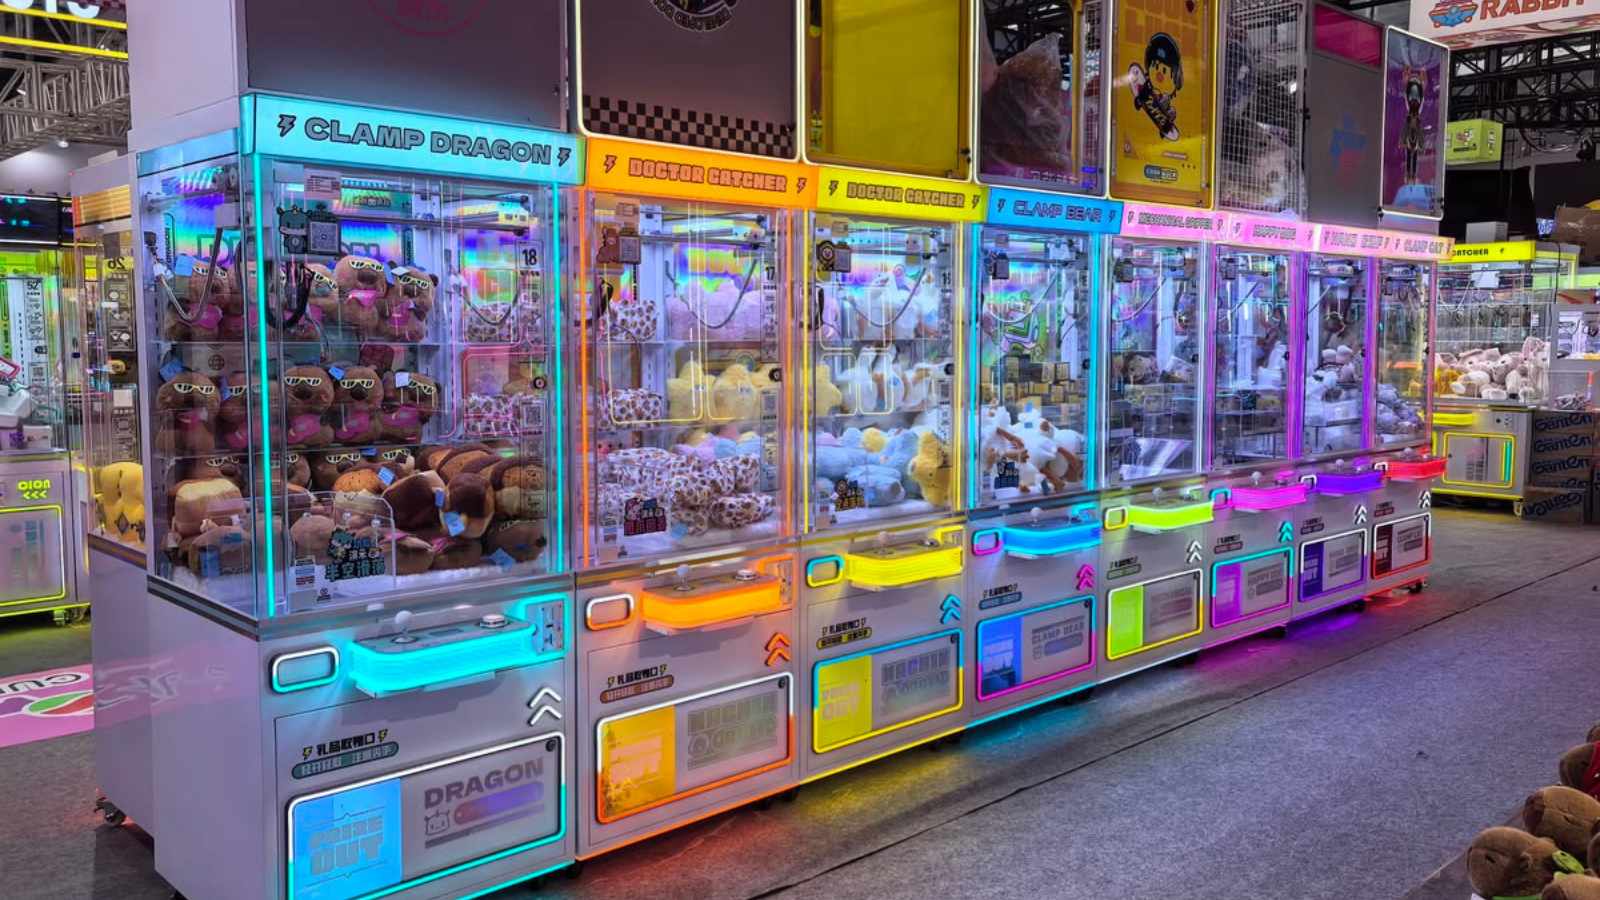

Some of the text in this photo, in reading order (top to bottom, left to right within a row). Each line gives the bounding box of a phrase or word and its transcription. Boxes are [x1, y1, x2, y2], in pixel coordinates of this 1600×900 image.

[1479, 0, 1586, 20] RABB
[304, 116, 552, 165] CLAMP DRAGON
[628, 157, 787, 193] DOCTOR CATCHER
[846, 181, 965, 209] DOCTOR CATCHER
[1013, 200, 1101, 223] CLAMP BEAR
[521, 248, 537, 266] 18
[764, 266, 776, 281] 17
[1031, 630, 1061, 645] CLAMP
[424, 757, 545, 810] DRAGON
[309, 814, 384, 849] PRIZE
[310, 834, 384, 876] OUT
